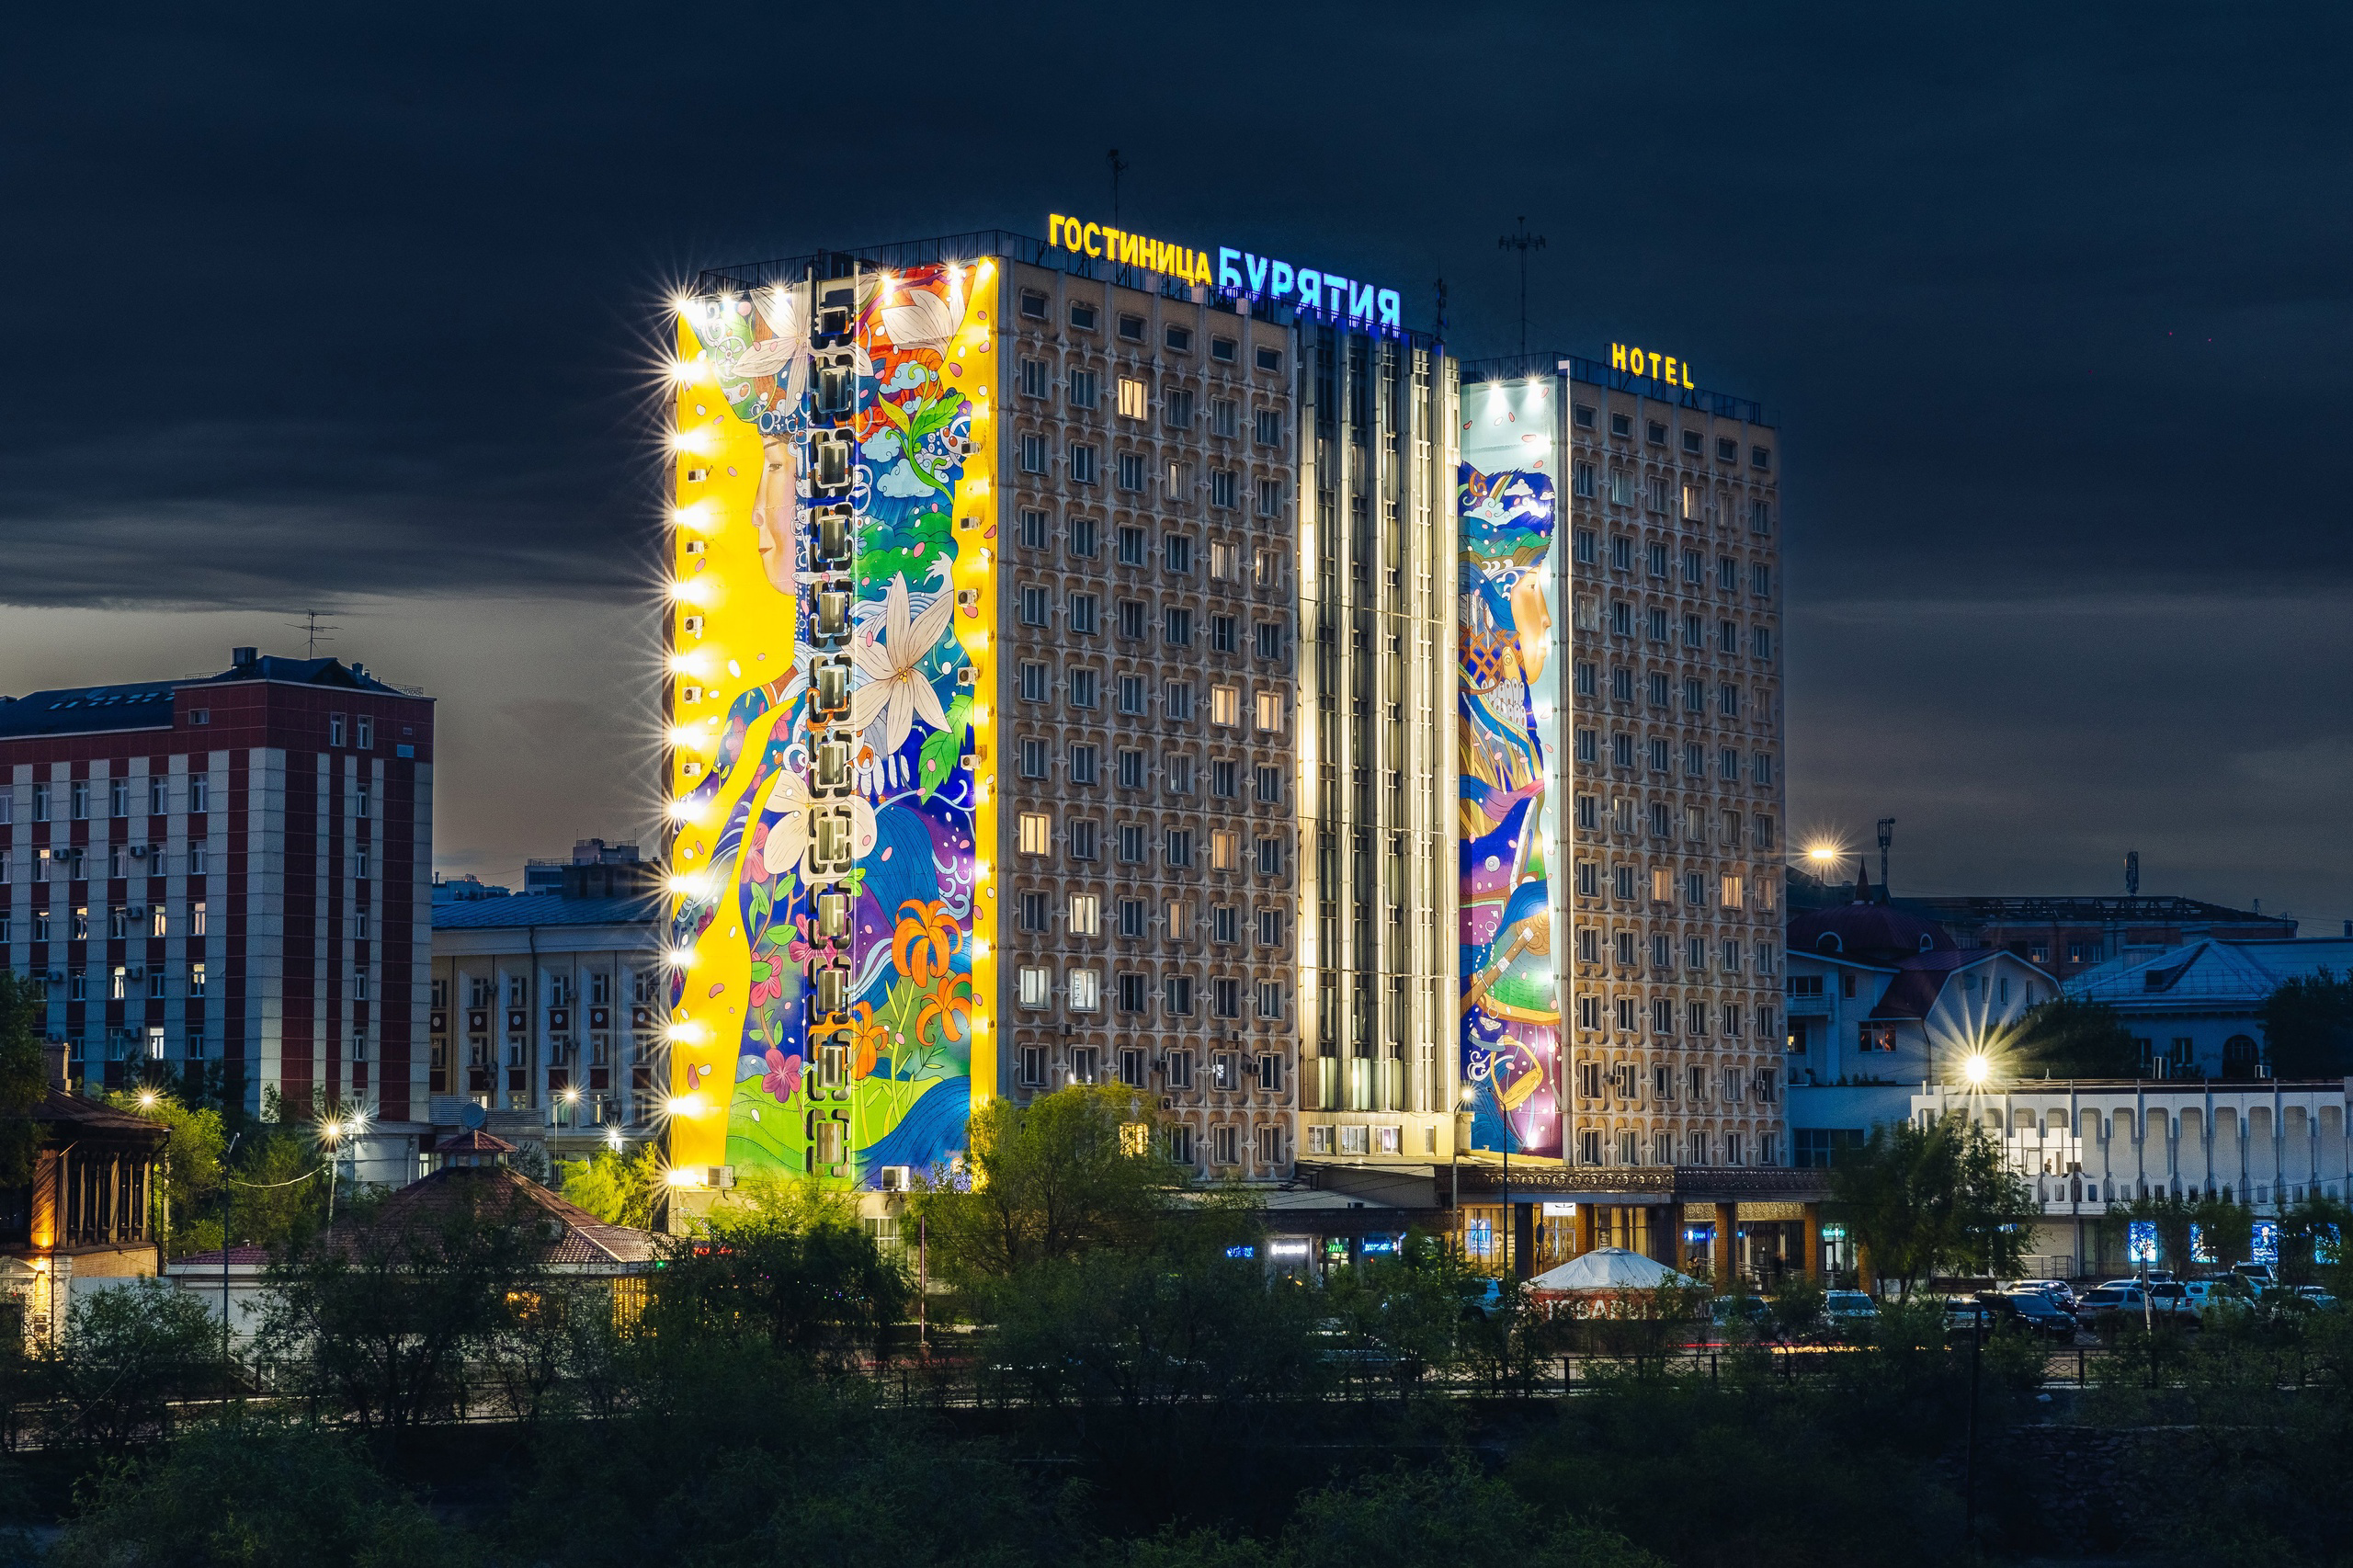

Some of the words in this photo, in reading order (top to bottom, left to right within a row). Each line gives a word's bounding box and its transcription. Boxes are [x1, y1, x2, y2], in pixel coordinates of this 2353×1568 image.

[1049, 213, 1212, 287] ГОСТИНИЦА
[1218, 245, 1401, 332] БУРЯТИЯ
[1611, 342, 1694, 390] HOTEL
